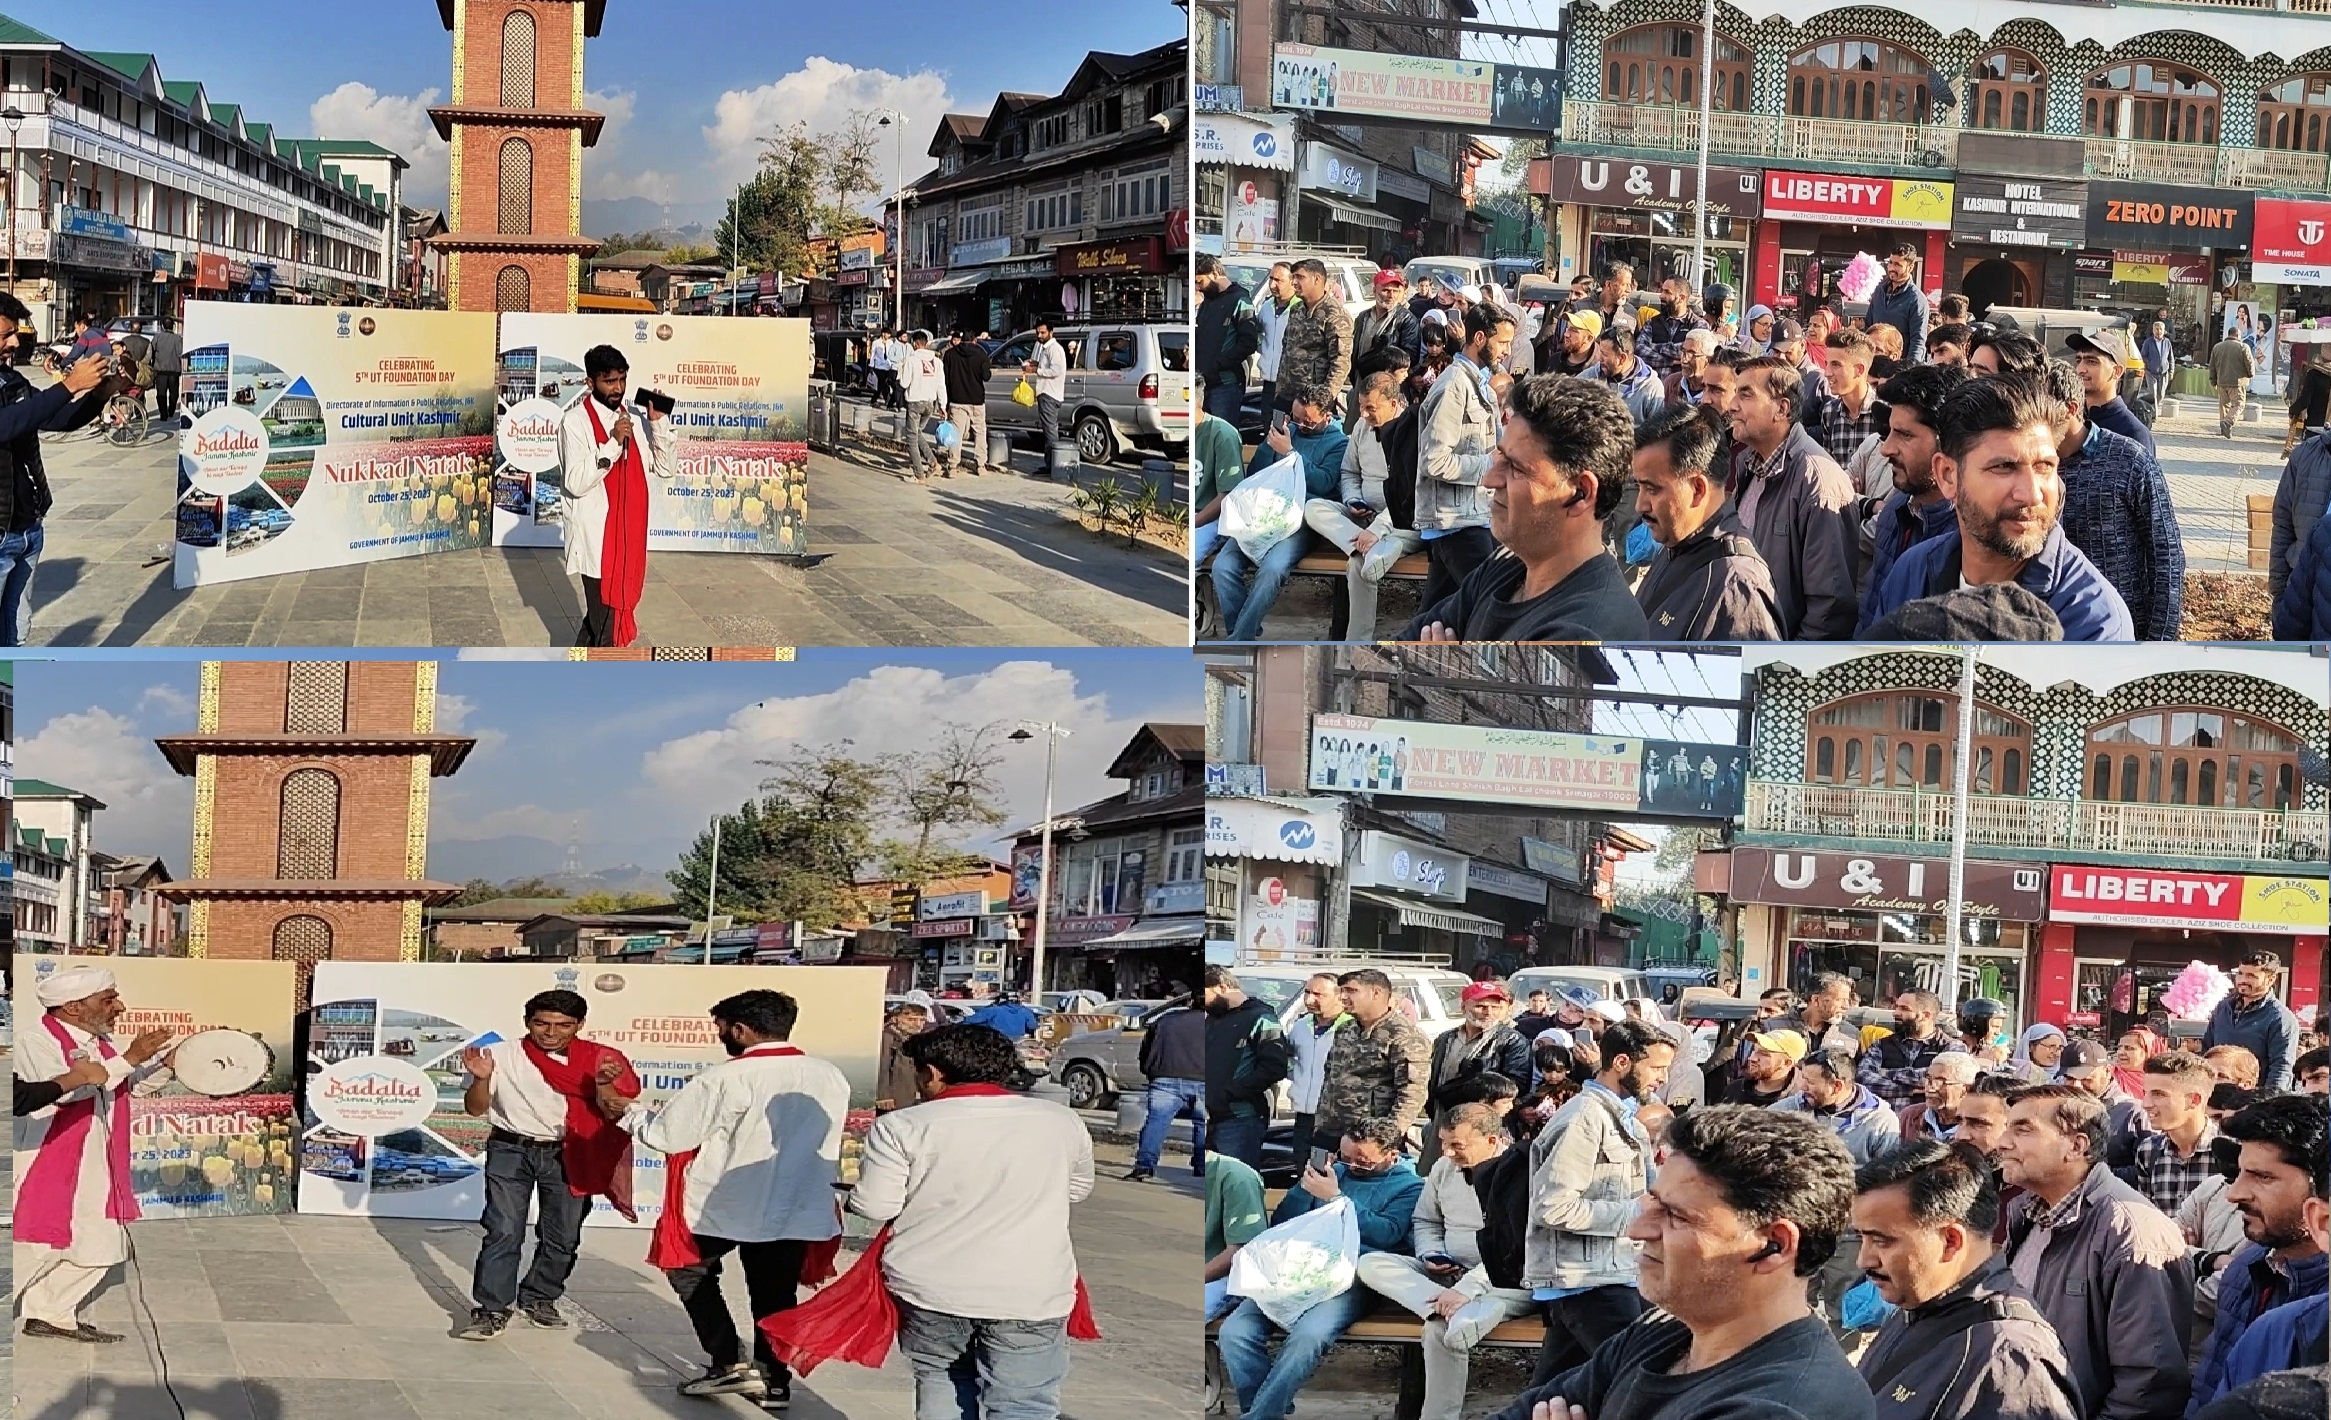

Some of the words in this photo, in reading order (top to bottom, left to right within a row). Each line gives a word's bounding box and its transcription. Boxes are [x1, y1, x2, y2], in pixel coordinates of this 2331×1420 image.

[1277, 45, 1295, 54] Estd.
[1297, 46, 1312, 55] 1974
[1340, 71, 1390, 95] NEW
[1395, 75, 1492, 104] MARKET
[1338, 97, 1357, 105] Forest
[1394, 102, 1411, 111] Bagh
[1421, 104, 1441, 112] chowk
[1580, 160, 1609, 191] U
[1624, 165, 1654, 198] &
[1669, 169, 1681, 198] I
[1771, 177, 1884, 206] LIBERTY
[1902, 185, 1918, 199] SHOE
[1919, 183, 1945, 202] STATION
[2004, 183, 2042, 200] HOTEL
[1633, 195, 1683, 211] Academy
[1704, 200, 1731, 214] Style
[1962, 197, 2007, 213] KASHMIR
[2010, 200, 2080, 219] INTERNATIONAL
[74, 208, 92, 222] HOTEL
[92, 210, 107, 224] LALA
[108, 214, 125, 226] RUKH
[1791, 212, 1829, 221] AUTHORISED
[1869, 217, 1886, 225] SHOE
[1886, 219, 1923, 227] COLLECTION
[2106, 200, 2164, 224] ZERO
[2169, 205, 2237, 229] POINT
[84, 224, 115, 237] RESTAURANT
[2016, 217, 2025, 230] &
[1990, 229, 2049, 246] RESTAURANT
[2116, 252, 2166, 264] LIBERTY
[2263, 248, 2280, 256] TIME
[2282, 249, 2305, 258] HOUSE
[1000, 261, 1026, 274] REGAL
[1030, 260, 1052, 273] SALE
[2284, 268, 2320, 279] SONATA
[870, 298, 877, 307] P
[379, 359, 435, 372] CELEBRATING
[677, 363, 737, 375] CELEBRATING
[355, 372, 369, 383] 5TH
[370, 372, 382, 383] UT
[383, 371, 437, 383] FOUNDATION
[438, 371, 455, 383] DAY
[653, 374, 667, 384] 5TH
[668, 375, 680, 385] UT
[681, 374, 740, 386] FOUNDATION
[741, 377, 760, 387] DAY
[326, 400, 362, 410] Directorate
[364, 400, 371, 409] of
[372, 399, 409, 409] Information
[410, 398, 415, 408] &
[416, 397, 434, 407] Public
[435, 396, 464, 407] Relations,
[464, 396, 475, 407] J&K
[674, 400, 710, 409] nformation
[717, 401, 737, 410] Public
[738, 402, 772, 411] Relations,
[772, 403, 784, 411] J&K
[341, 413, 389, 429] Cultural
[391, 411, 415, 428] Unit
[417, 409, 461, 426] Kashmir
[690, 412, 716, 427] Unit
[718, 414, 768, 428] Kashmir
[389, 435, 415, 444] Presents
[689, 434, 716, 442] Presents
[201, 453, 228, 462] Jammu
[228, 450, 257, 460] Kashmir
[324, 457, 410, 485] Nukkad
[413, 452, 474, 477] Natak
[714, 456, 783, 480] Natak
[368, 492, 398, 504] October
[400, 491, 412, 503] 25,
[412, 489, 431, 500] 2023
[667, 486, 700, 497] October
[700, 487, 714, 498] 25,
[715, 488, 735, 498] 2023
[349, 537, 390, 550] GOVERNMENT
[390, 536, 399, 545] OF
[399, 535, 419, 546] JAMMU
[418, 534, 424, 542] &
[424, 530, 450, 542] KASHMIR
[649, 529, 690, 539] GOVERNMENT
[691, 530, 700, 538] OF
[700, 530, 722, 540] JAMMU
[722, 530, 728, 539] &
[729, 530, 758, 540] KASHMIR
[1317, 716, 1343, 728] Estd.
[1346, 718, 1369, 730] 1974
[1411, 747, 1487, 777] NEW
[1495, 753, 1640, 788] MARKET
[1408, 777, 1438, 788] Forest
[1461, 781, 1493, 791] Sheikh
[1494, 783, 1517, 795] Bagh
[1518, 785, 1534, 794] Lal
[1534, 786, 1562, 796] chowk
[1773, 853, 1816, 890] U
[1840, 859, 1883, 895] &
[1908, 862, 1925, 897] I
[2061, 873, 2230, 908] LIBERTY
[2257, 880, 2283, 900] SHOE
[2284, 880, 2323, 904] STATION
[1851, 895, 1927, 912] Academy
[1959, 900, 2001, 917] Style
[2092, 914, 2148, 924] AUTHORISED
[2187, 919, 2206, 928] AZIZ
[2208, 920, 2232, 929] SHOE
[2234, 922, 2290, 932] COLLECTION
[983, 952, 994, 964] P
[119, 1011, 194, 1023] LEBRATING
[587, 1030, 612, 1041] 5TH
[615, 1031, 638, 1043] UT
[640, 1031, 720, 1045] FOUNDAT
[158, 1111, 259, 1137] Natak
[161, 1149, 192, 1160] 2023
